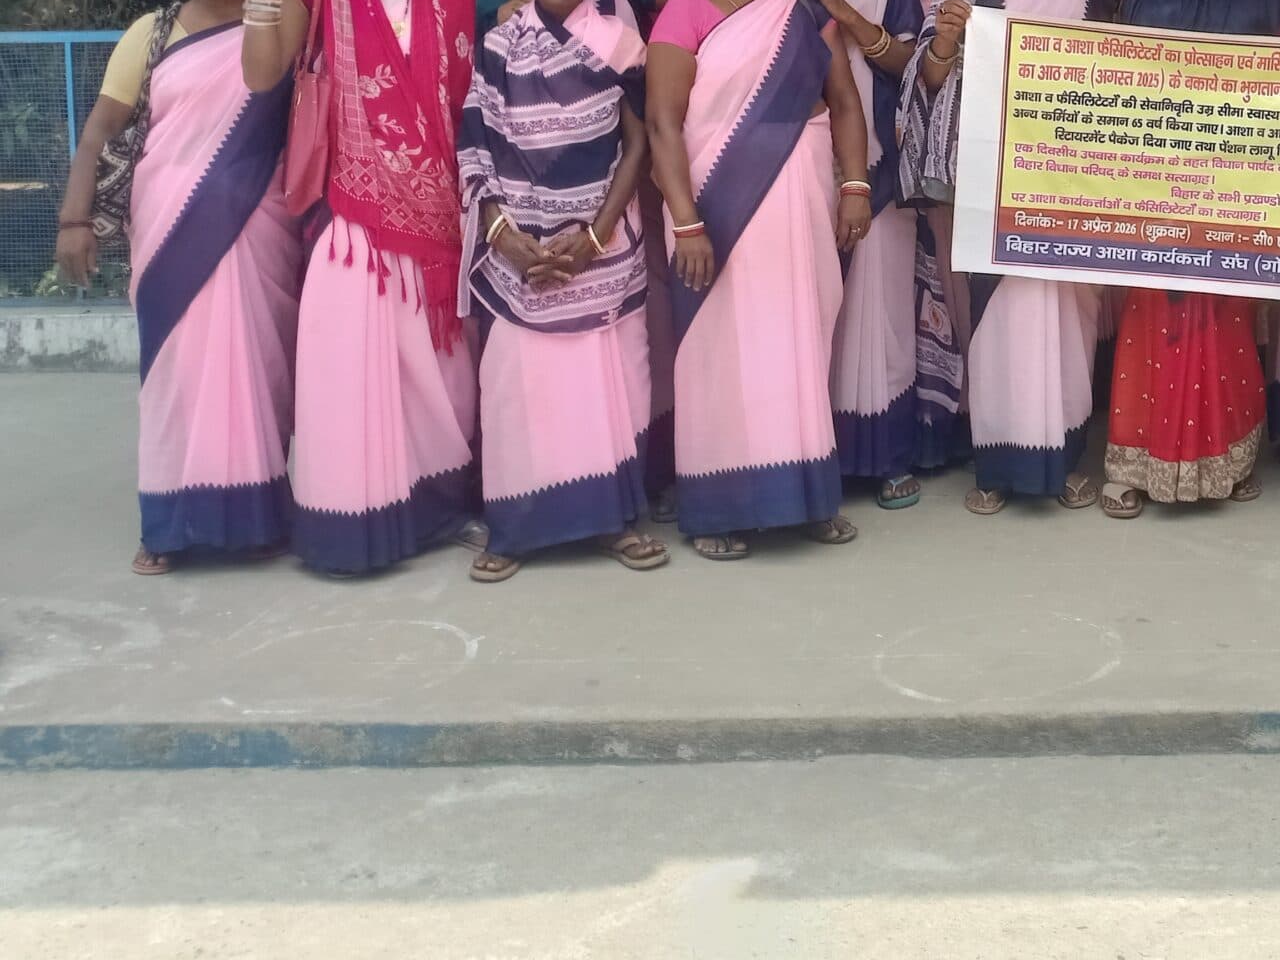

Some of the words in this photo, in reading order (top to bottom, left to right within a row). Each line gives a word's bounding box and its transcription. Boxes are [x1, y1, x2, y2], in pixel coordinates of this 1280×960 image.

[1020, 35, 1050, 52] आशा
[1053, 38, 1062, 53] व
[1065, 39, 1094, 55] आशा
[1165, 49, 1180, 63] का
[1184, 46, 1234, 68] प्रोत्साहन
[1237, 51, 1256, 69] एवं
[1019, 63, 1035, 78] का
[1037, 64, 1062, 81] आठ
[1064, 66, 1087, 84] माह
[1090, 62, 1135, 89] (अगस्त
[1136, 68, 1165, 93] 2025)
[1169, 70, 1183, 89] के
[1221, 79, 1237, 93] का
[1014, 90, 1041, 102] आशा
[1045, 92, 1053, 103] व
[1122, 95, 1137, 109] की
[1197, 104, 1214, 117] उम्र
[1217, 103, 1243, 117] सीमा
[1013, 108, 1038, 120] अन्य
[1041, 108, 1080, 123] कर्मियों
[1081, 112, 1093, 124] के
[1097, 115, 1129, 127] समान
[1131, 118, 1143, 128] 65
[1146, 116, 1163, 130] वर्ष
[1166, 117, 1193, 132] किया
[1226, 125, 1254, 137] आशा
[1256, 128, 1266, 138] व
[1015, 143, 1033, 153] एक
[1037, 143, 1077, 157] दिवसीय
[1081, 150, 1117, 161] उपवास
[1120, 152, 1165, 165] कार्यक्रम
[1168, 155, 1180, 166] के
[1183, 157, 1208, 168] तहत
[1212, 157, 1244, 170] विधान
[1055, 127, 1107, 143] रिटायरमेंट
[1109, 131, 1139, 147] पैकेज
[1143, 133, 1167, 148] दिया
[1169, 139, 1193, 151] जाए
[1195, 141, 1216, 152] तथा
[1219, 140, 1246, 154] पेंशन
[1249, 145, 1275, 160] लागू
[1014, 157, 1043, 170] बिहार
[1046, 160, 1078, 174] विधान
[1117, 166, 1130, 178] के
[1132, 170, 1162, 181] समक्ष
[1011, 192, 1026, 203] पर
[1029, 193, 1056, 204] आशा
[1123, 200, 1131, 210] व
[1198, 208, 1213, 217] का
[1171, 186, 1200, 200] बिहार
[1202, 189, 1214, 201] के
[1218, 190, 1241, 203] सभी
[1067, 220, 1078, 231] 17
[1114, 222, 1137, 235] 2026
[1205, 230, 1234, 243] स्थान
[1005, 235, 1051, 254] बिहार
[1053, 242, 1092, 257] राज्य
[1095, 245, 1136, 261] आशा
[1220, 252, 1249, 270] संघ
